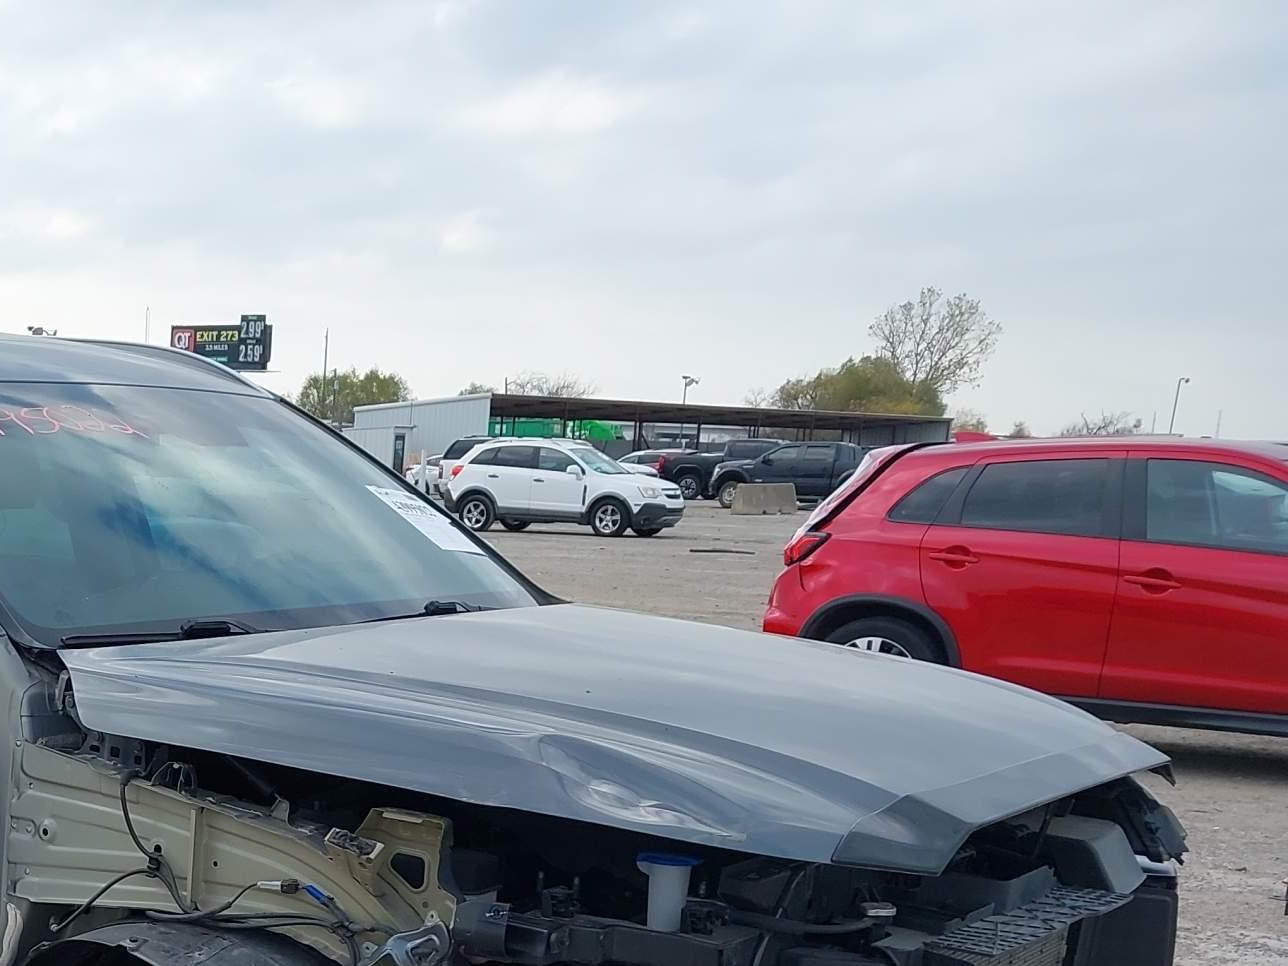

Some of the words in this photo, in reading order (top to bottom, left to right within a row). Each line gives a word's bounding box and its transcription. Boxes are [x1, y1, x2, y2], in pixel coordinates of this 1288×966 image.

[174, 332, 191, 349] QT
[196, 331, 218, 342] EXIT
[220, 331, 238, 341] 273
